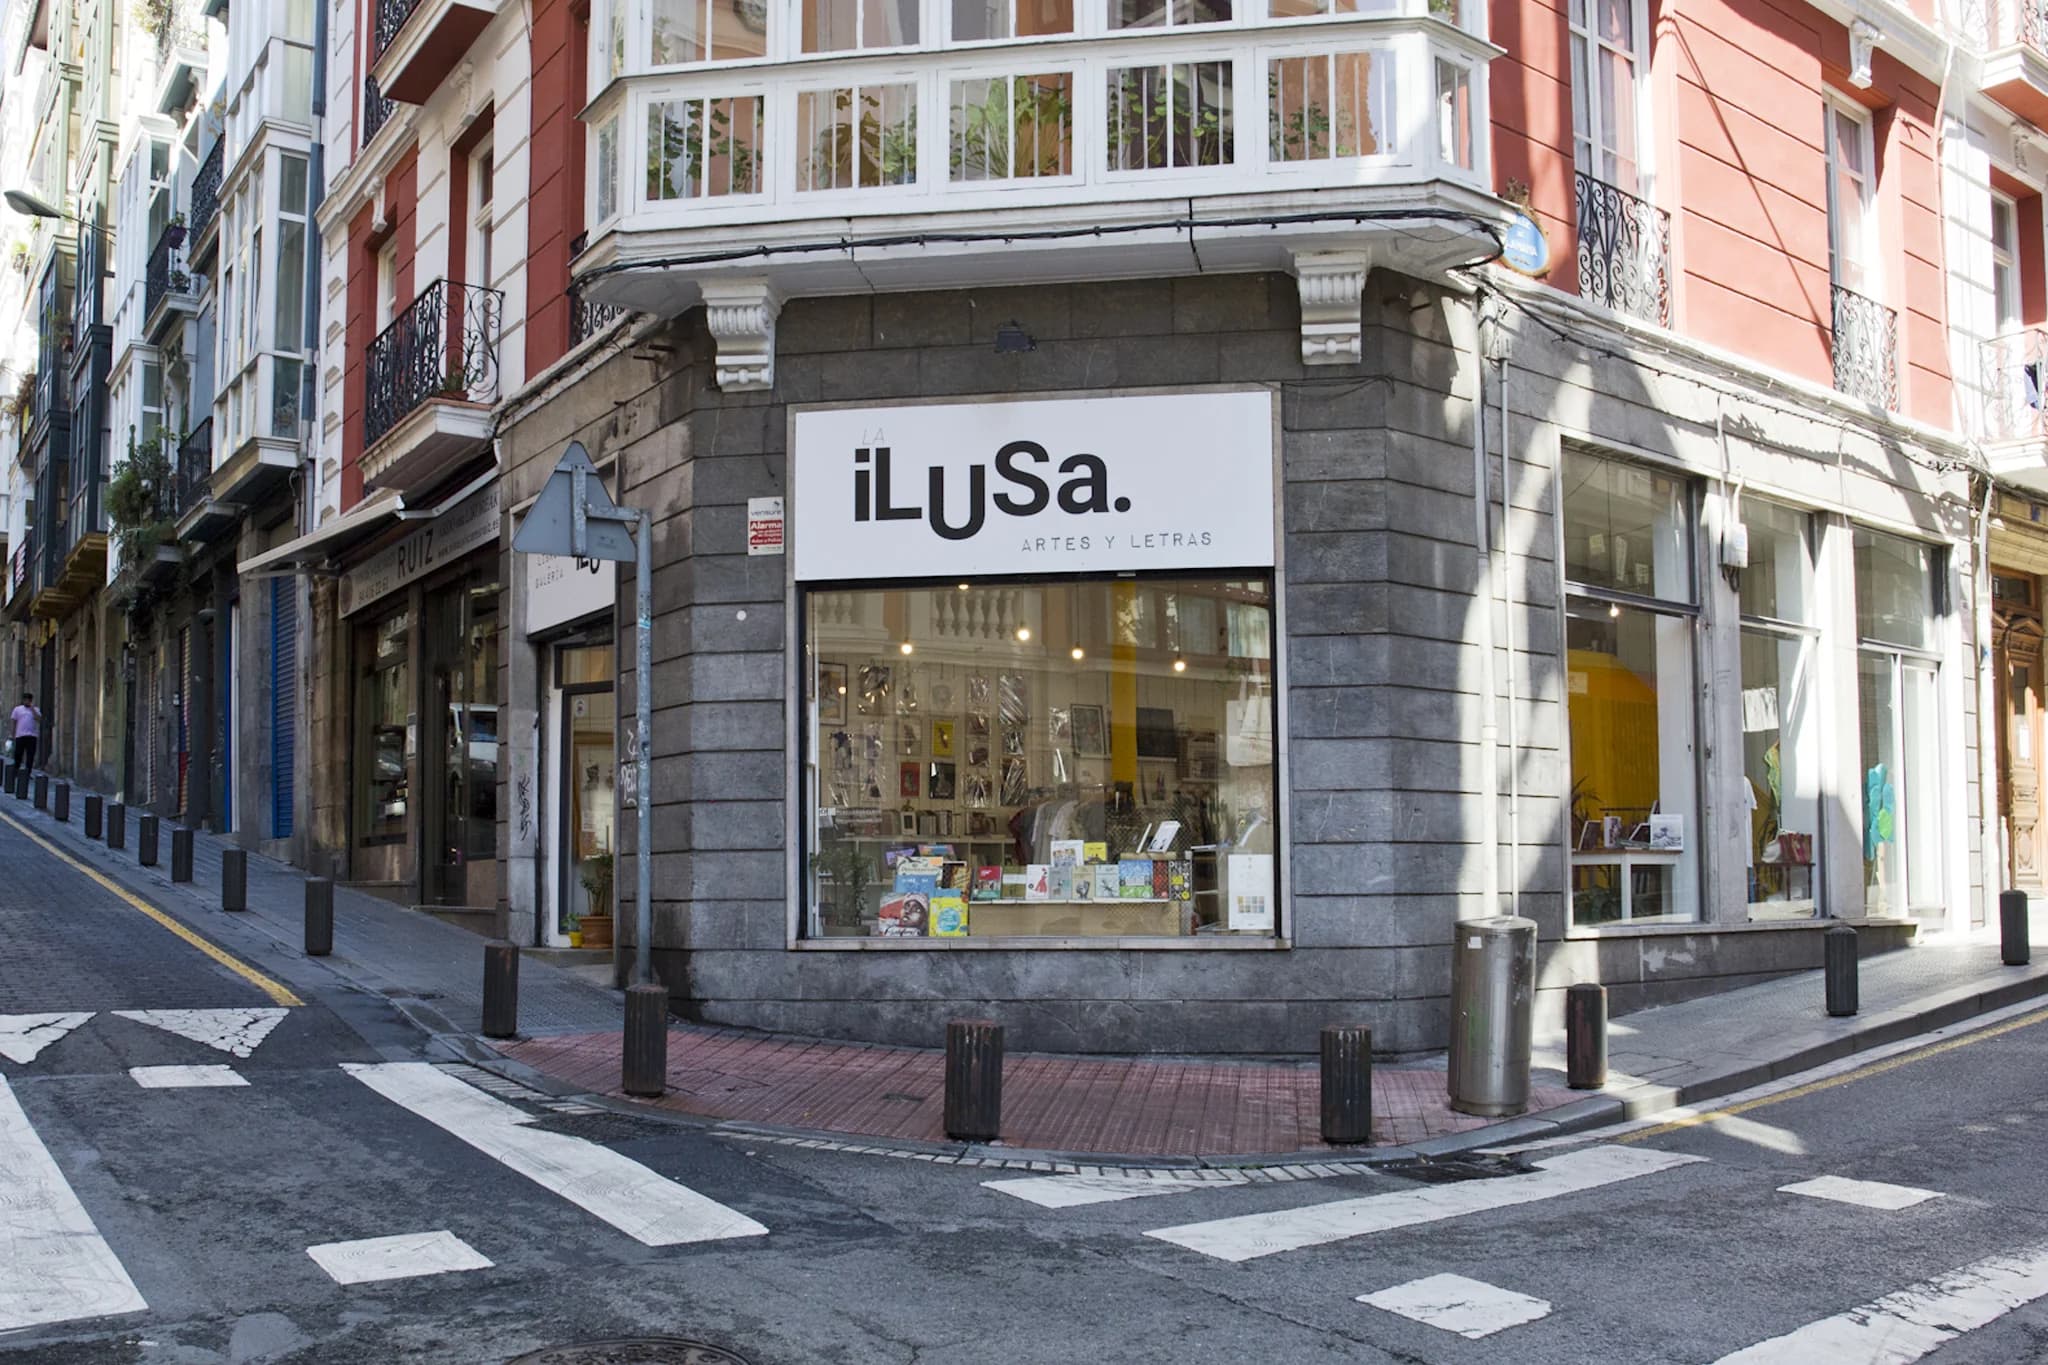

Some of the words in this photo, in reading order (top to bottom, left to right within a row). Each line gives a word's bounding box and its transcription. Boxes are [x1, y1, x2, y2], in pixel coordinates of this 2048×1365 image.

[397, 528, 434, 580] RUIZ
[1021, 536, 1091, 552] ARTES
[1104, 535, 1116, 549] Y
[1130, 532, 1213, 548] LETRAS
